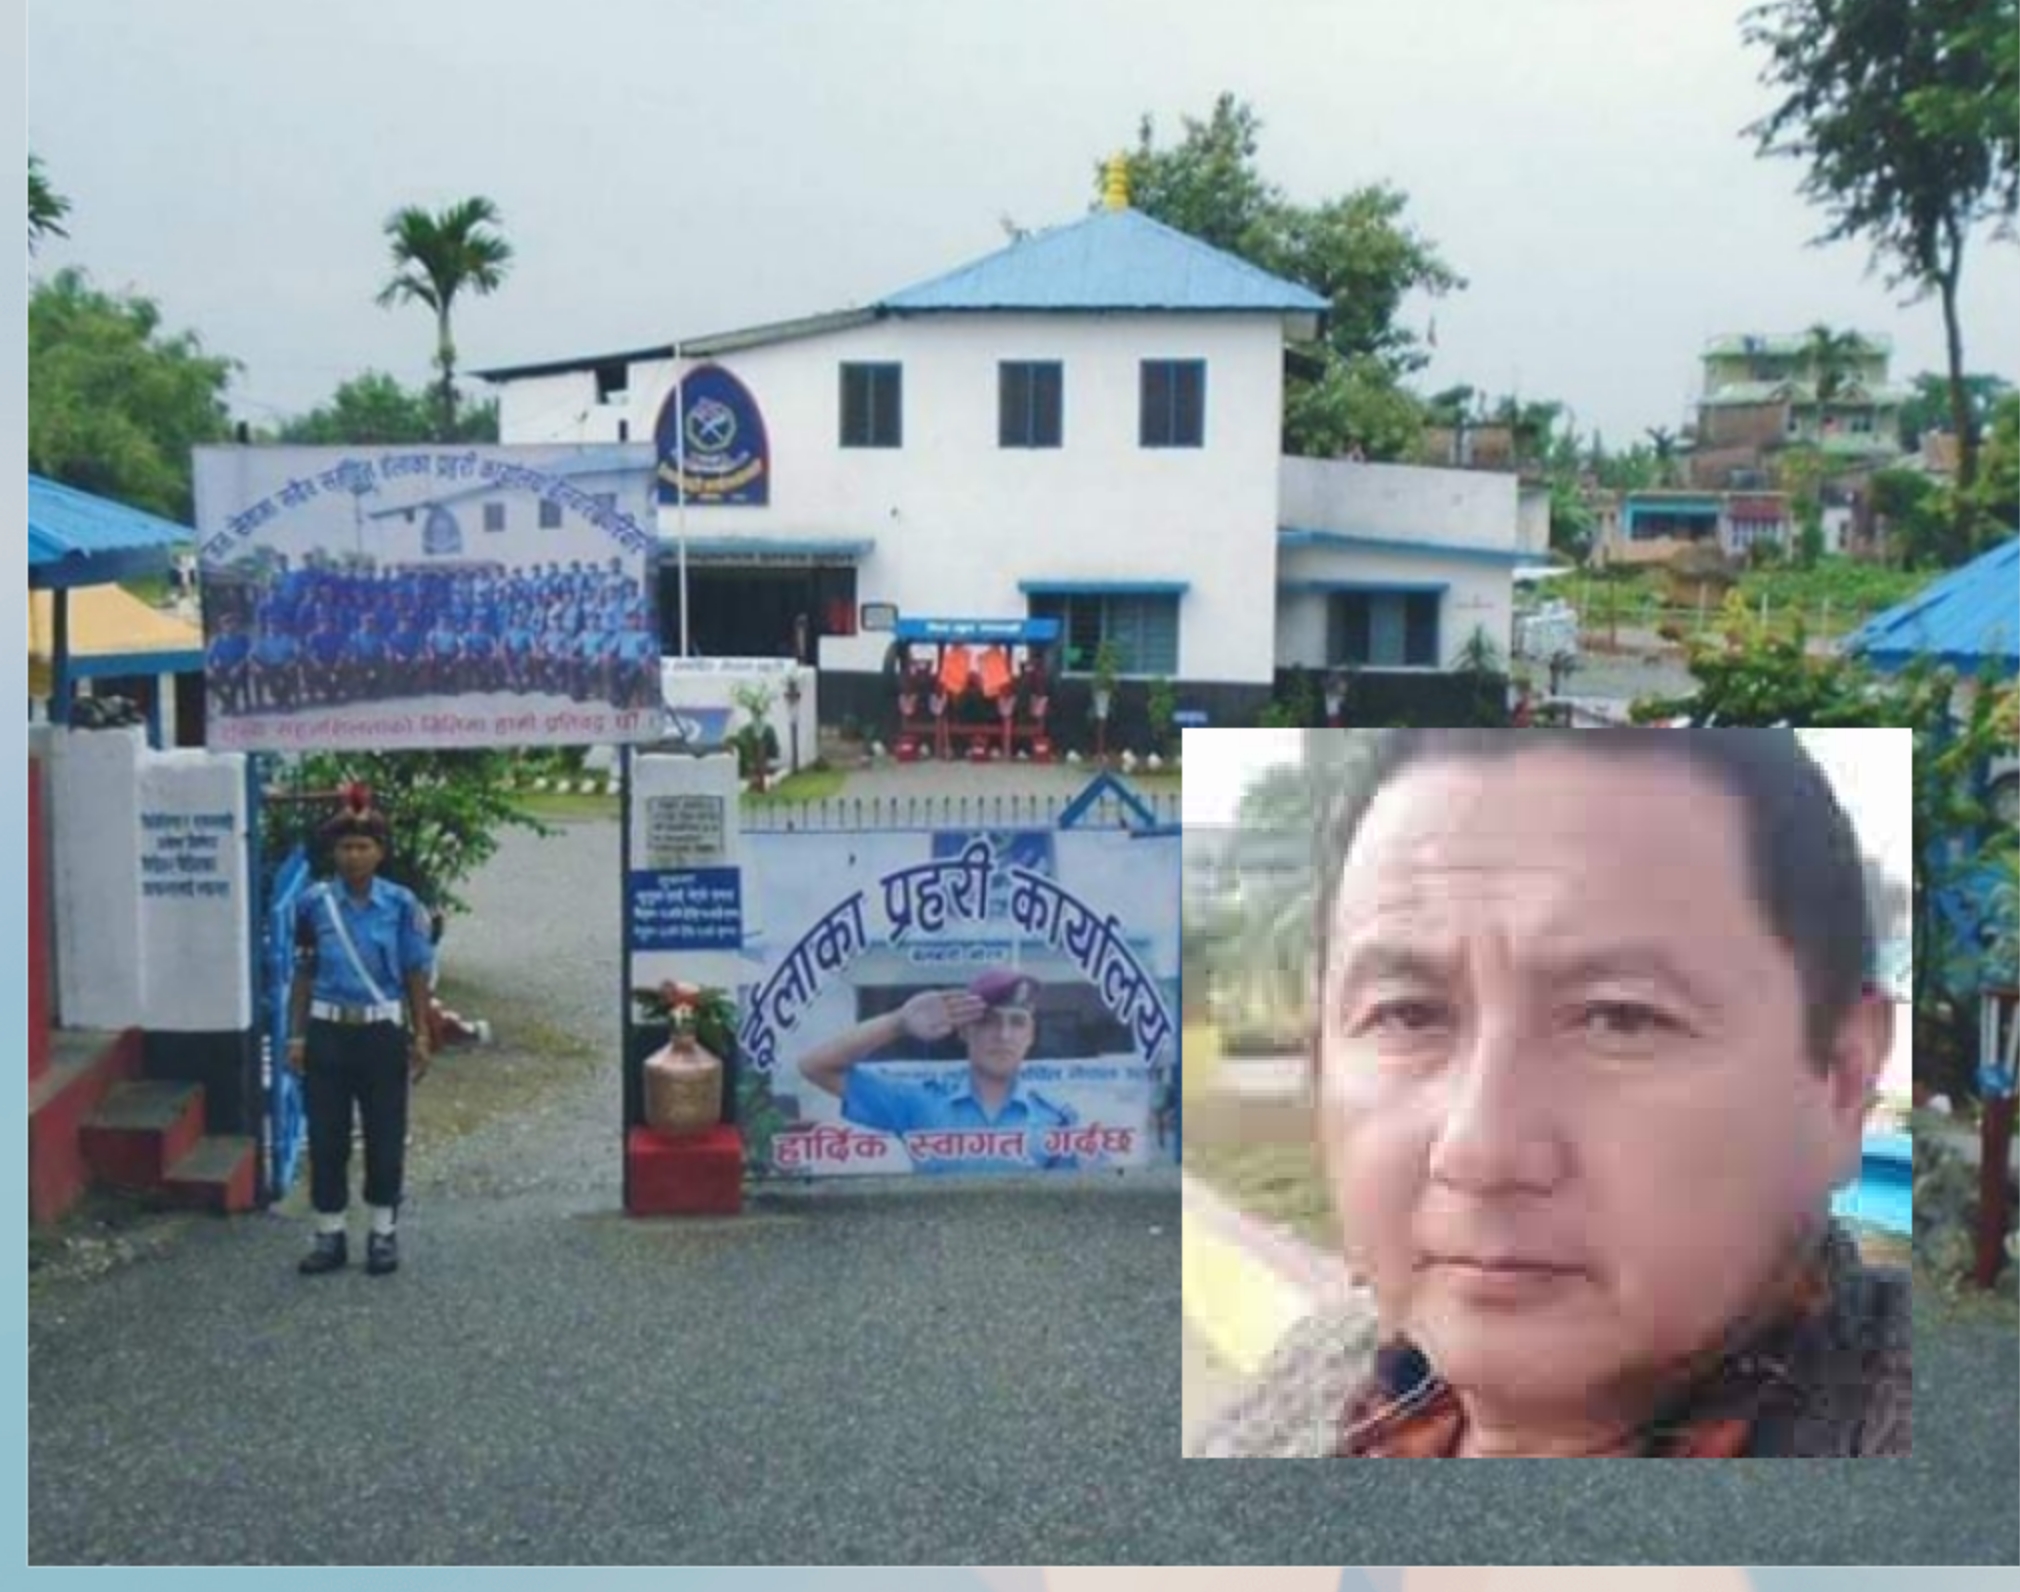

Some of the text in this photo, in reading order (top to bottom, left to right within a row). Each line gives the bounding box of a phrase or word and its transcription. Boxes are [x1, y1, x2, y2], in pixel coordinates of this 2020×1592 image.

[740, 840, 1171, 1068] ईलाका प्रहरी कार्यालय
[774, 1126, 888, 1165] हार्दिक
[1045, 1123, 1134, 1159] गर्दछ
